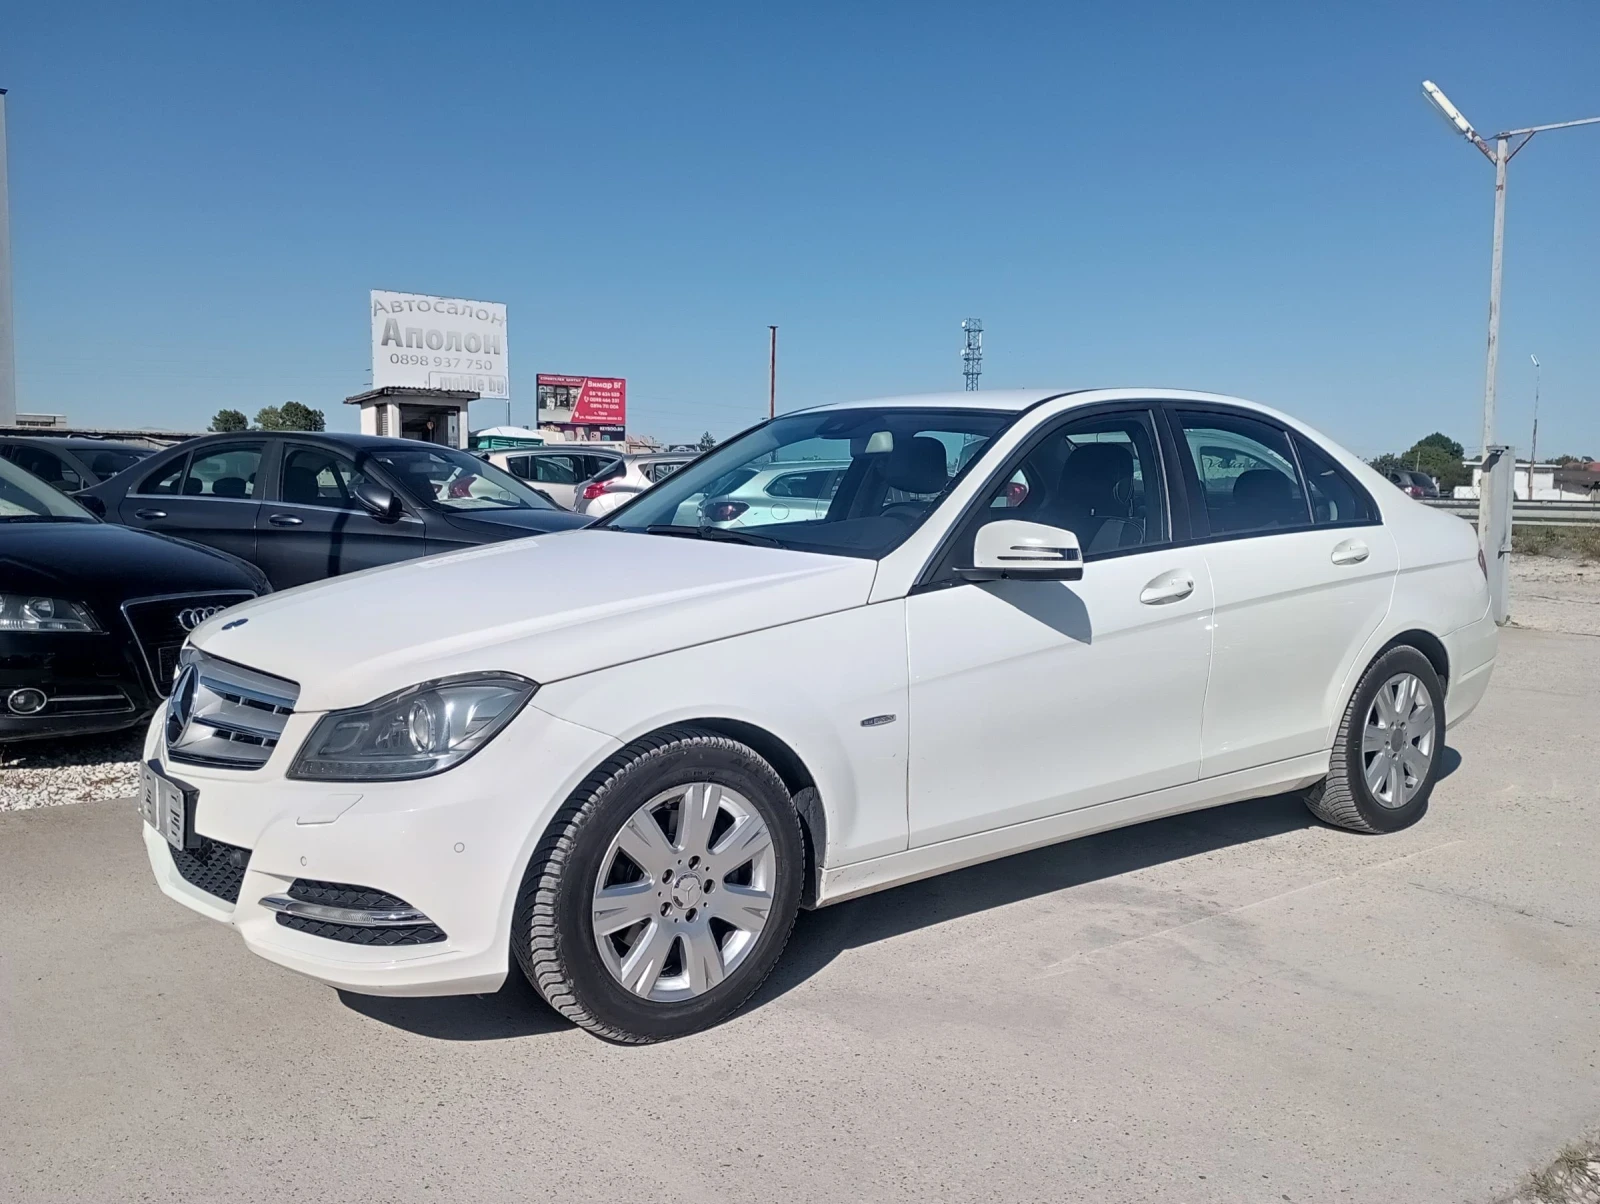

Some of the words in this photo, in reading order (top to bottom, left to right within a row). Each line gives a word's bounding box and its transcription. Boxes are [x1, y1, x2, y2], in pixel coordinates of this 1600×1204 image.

[373, 299, 505, 327] Автосалон
[381, 317, 501, 355] Аполон
[390, 353, 429, 366] 0898
[433, 356, 461, 369] 937
[466, 358, 493, 371] 750
[587, 381, 613, 389] Вимар
